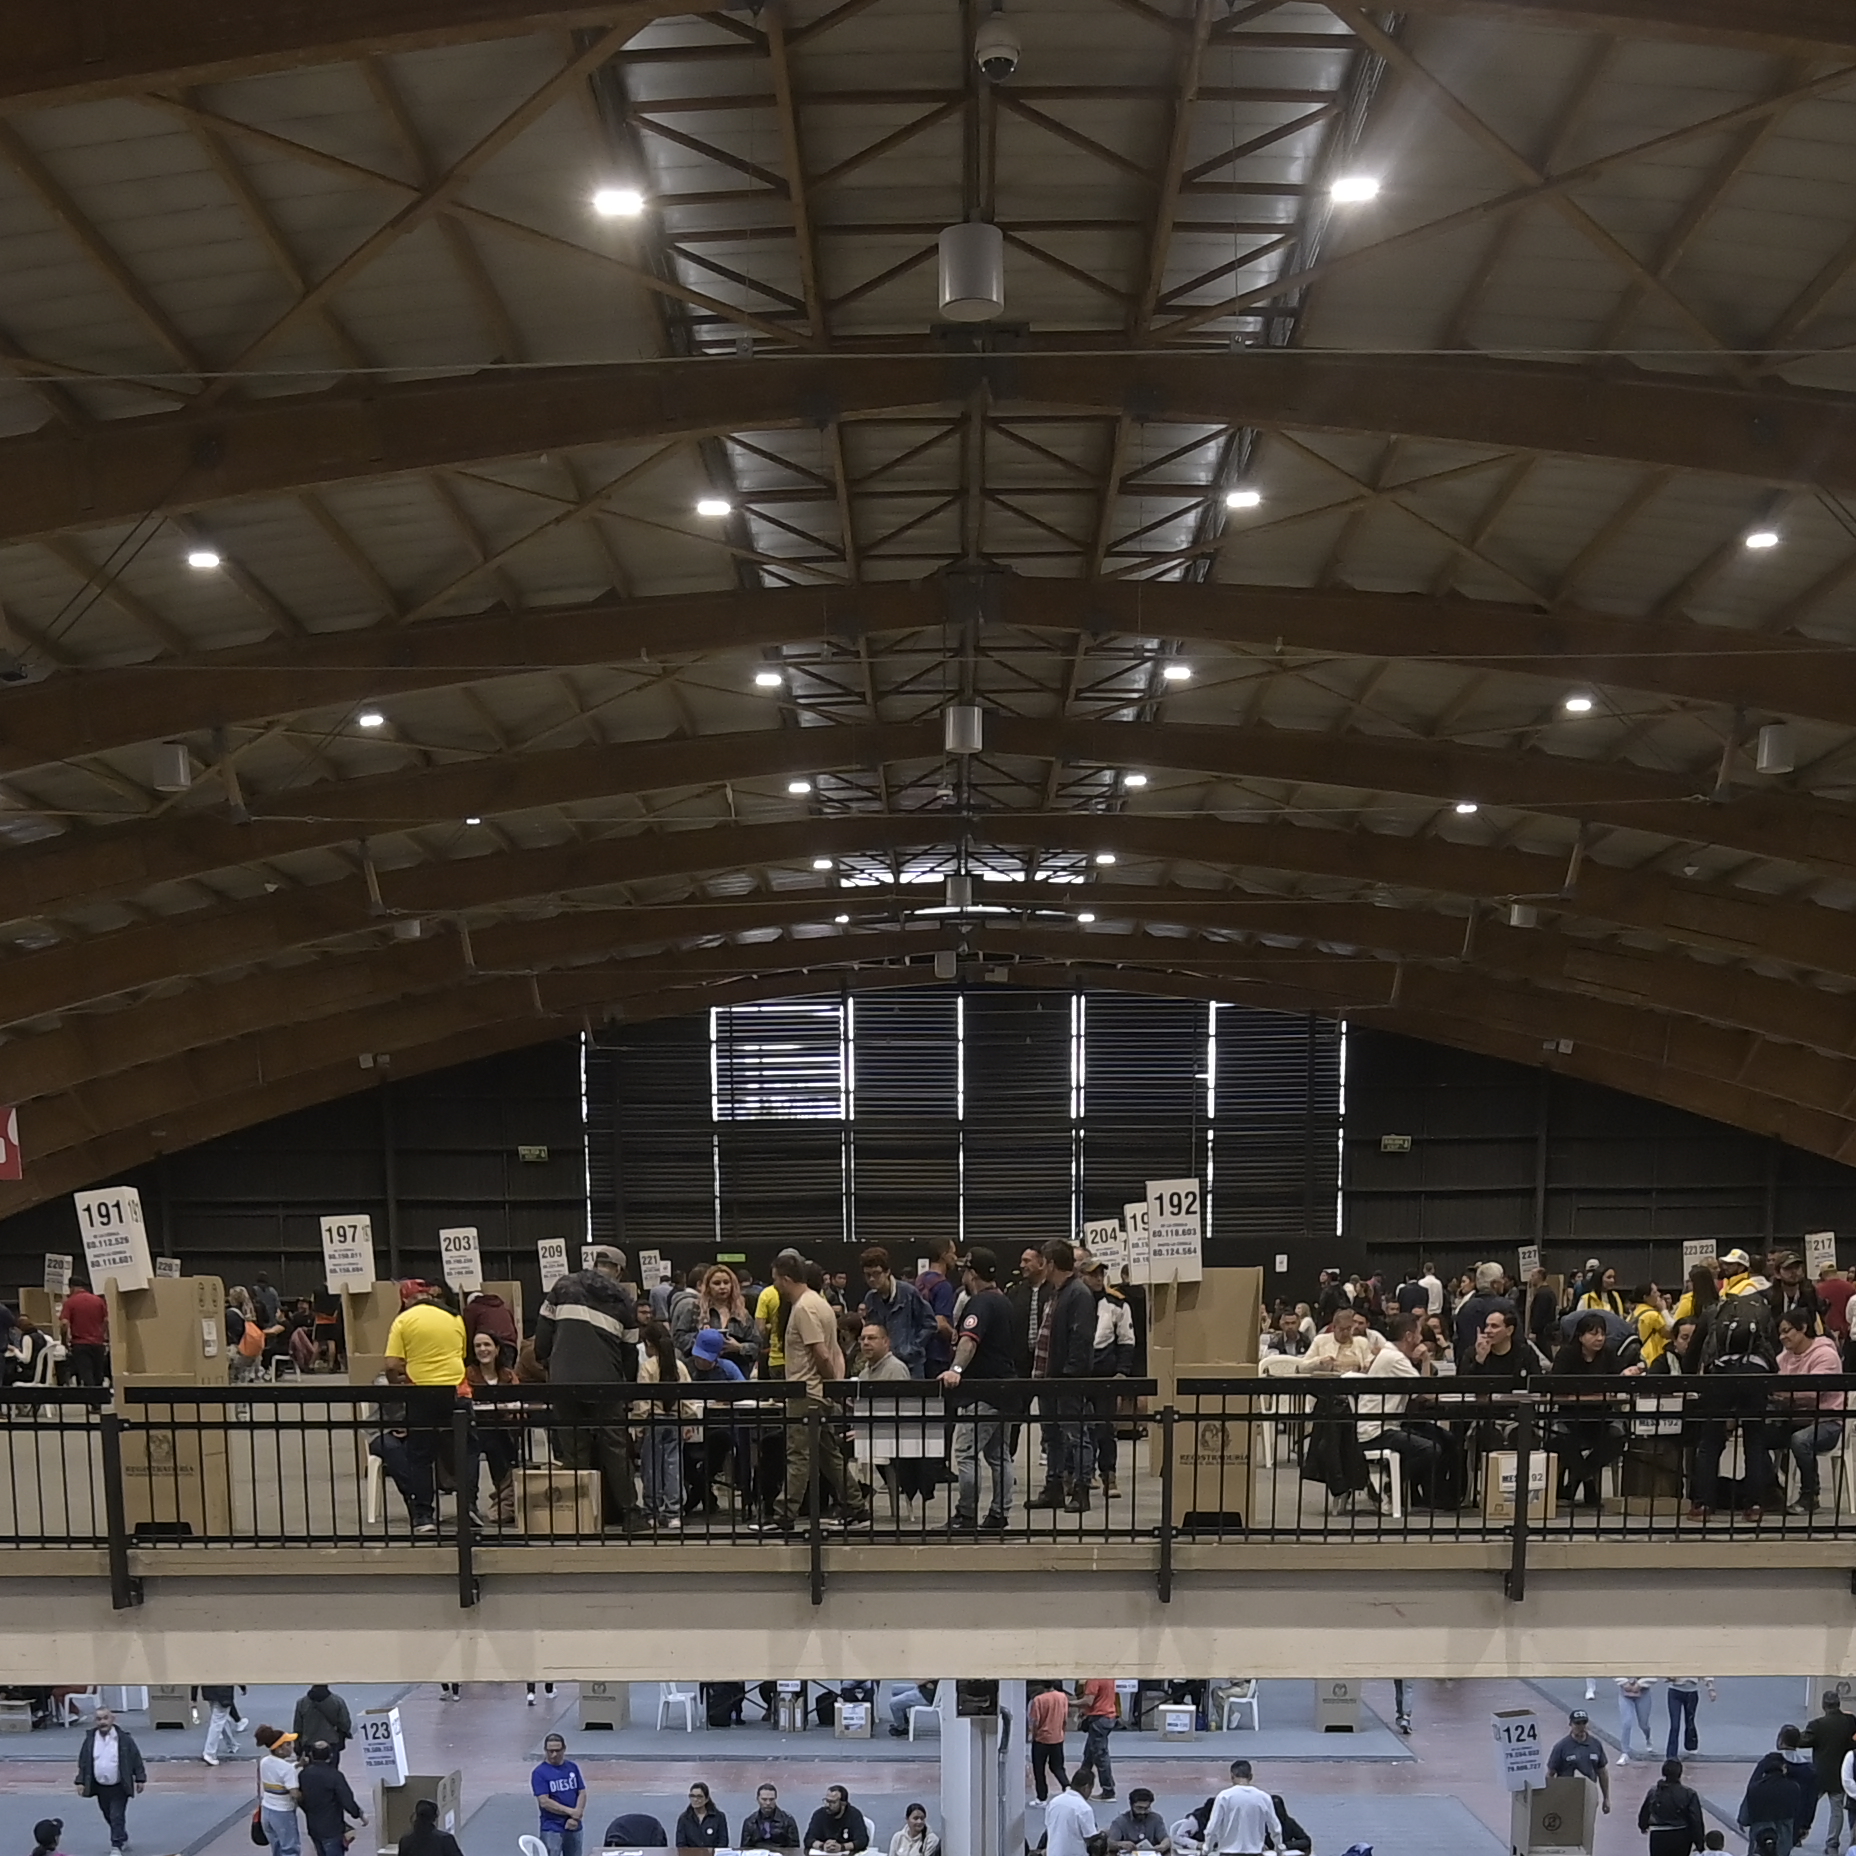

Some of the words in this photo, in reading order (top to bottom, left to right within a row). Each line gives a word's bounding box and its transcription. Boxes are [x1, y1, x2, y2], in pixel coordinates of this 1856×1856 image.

[1154, 1191, 1199, 1217] 192
[82, 1199, 124, 1228] 191
[1129, 1212, 1149, 1234] 19
[325, 1224, 358, 1244] 197
[1089, 1227, 1119, 1246] 204
[443, 1235, 472, 1252] 203
[540, 1244, 562, 1258] 209
[1699, 1243, 1714, 1255] 223
[1813, 1238, 1832, 1251] 217
[47, 1258, 64, 1270] 220
[583, 1250, 596, 1263] 21
[642, 1254, 658, 1266] 221
[361, 1721, 391, 1741] 123
[1502, 1723, 1538, 1744] 124
